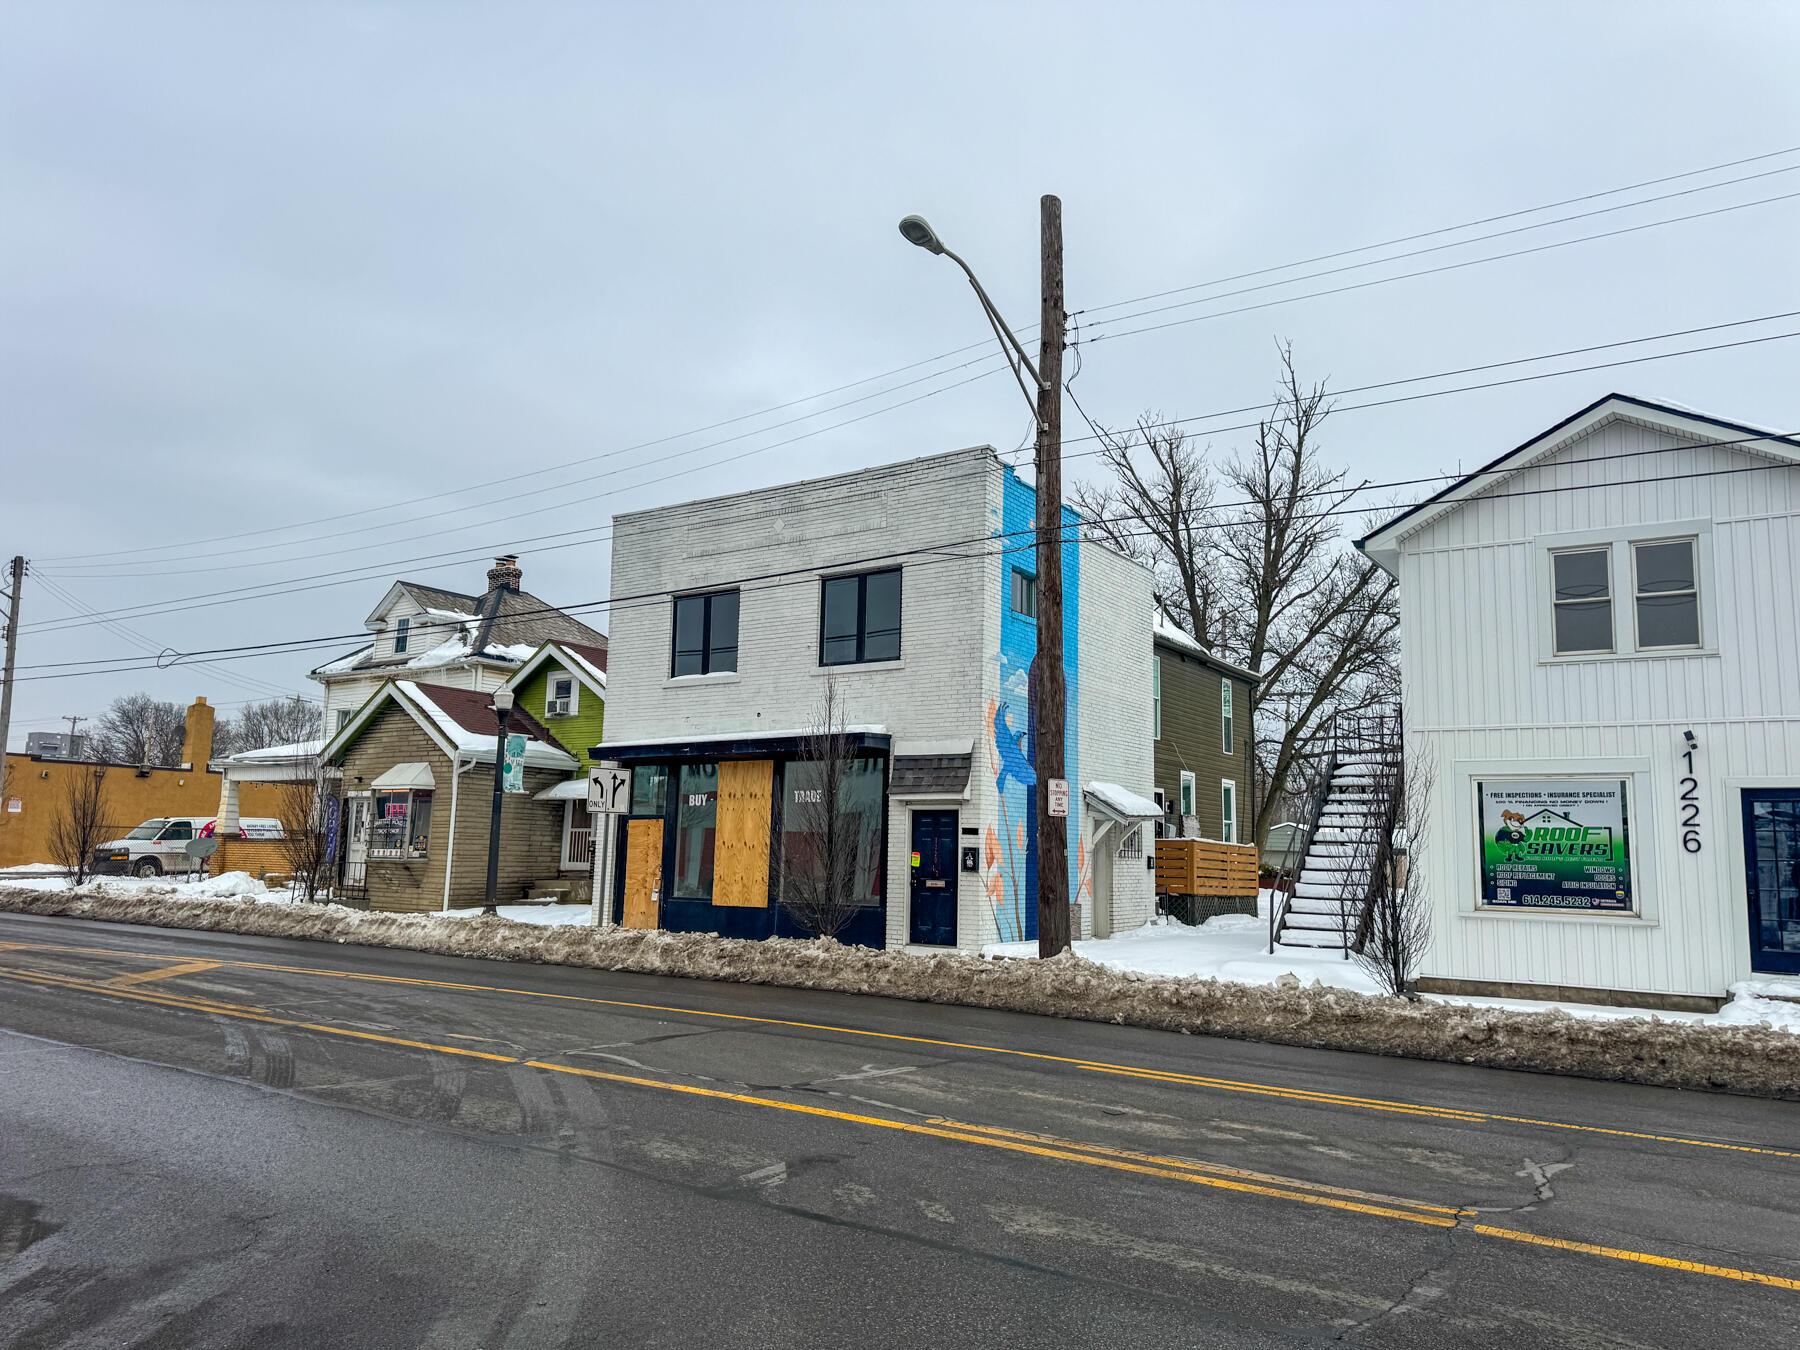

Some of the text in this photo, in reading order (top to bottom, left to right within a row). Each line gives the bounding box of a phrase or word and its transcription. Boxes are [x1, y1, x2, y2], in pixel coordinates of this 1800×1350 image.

[689, 794, 708, 806] BUY
[794, 790, 822, 803] TRADE
[1680, 750, 1702, 854] 1226
[1533, 827, 1603, 842] ROOF
[1526, 842, 1608, 856] SAVERS
[1513, 872, 1555, 880] REPLACEMENT
[1580, 881, 1616, 890] INSULATION
[1522, 895, 1591, 907] 614.245.5232
